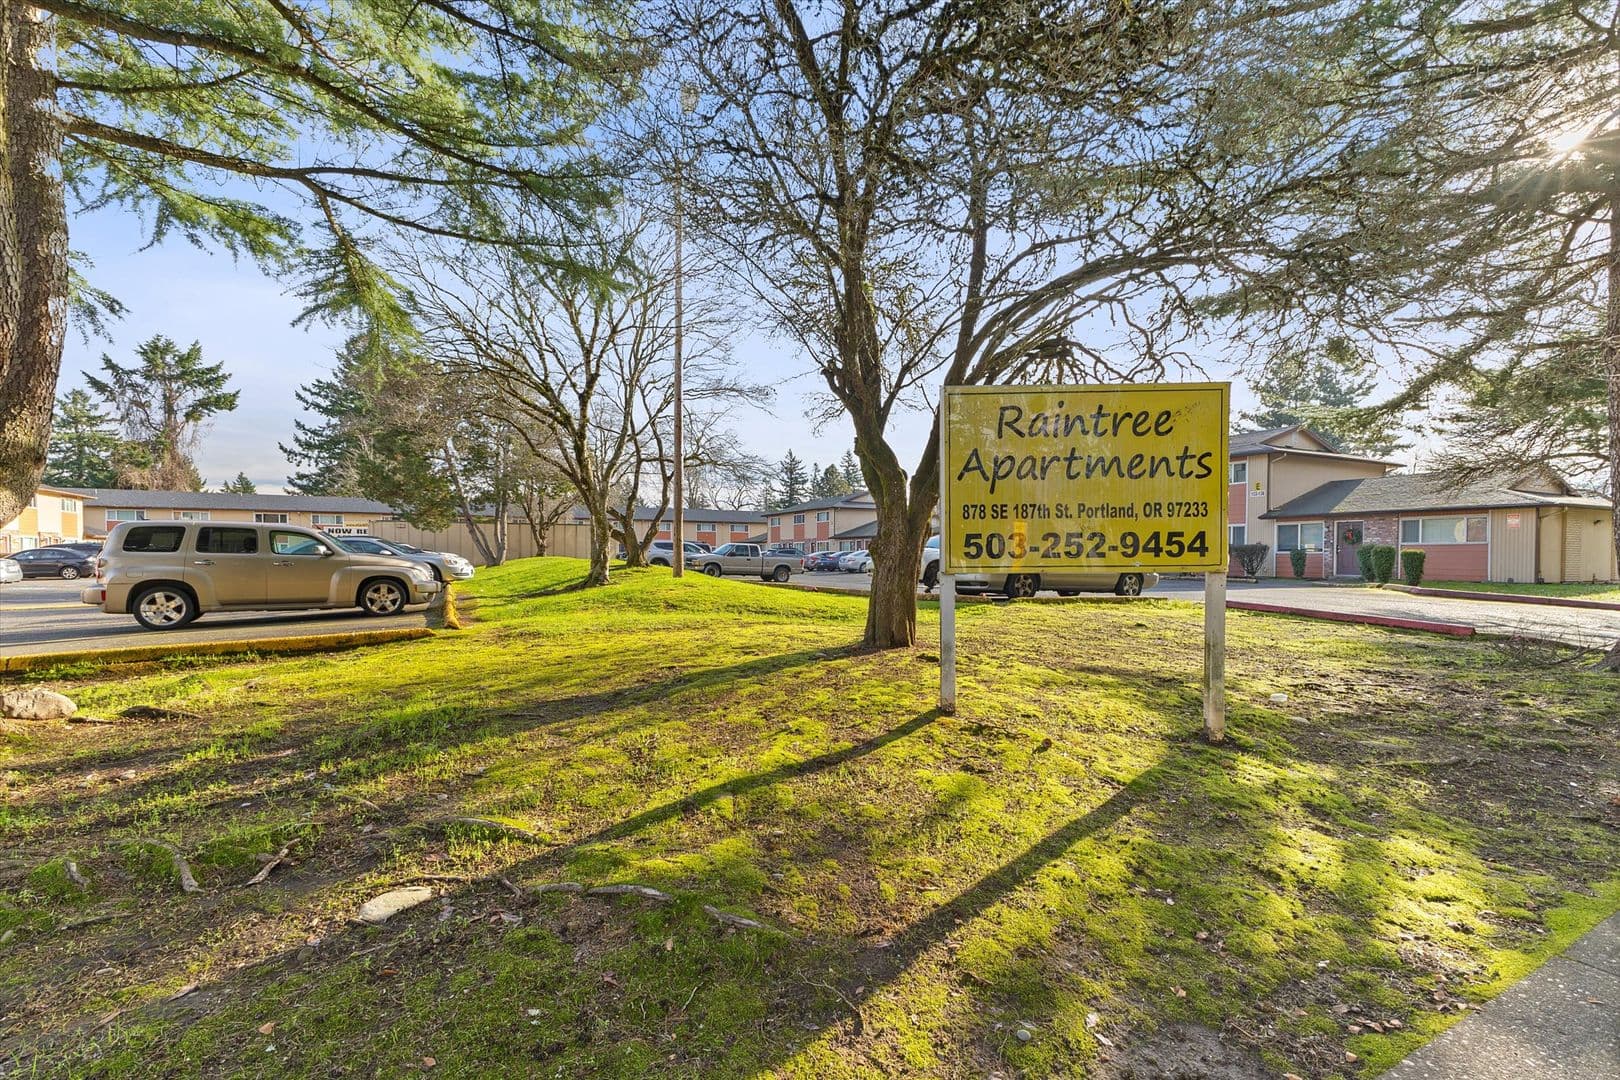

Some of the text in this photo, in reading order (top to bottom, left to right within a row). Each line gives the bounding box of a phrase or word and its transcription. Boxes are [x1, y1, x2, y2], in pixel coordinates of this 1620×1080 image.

[997, 400, 1174, 440] Raintree
[957, 445, 1214, 495] Apartments
[962, 501, 1208, 521] 878 SE 187th St. Portland, OR 97233
[327, 527, 352, 535] NOW
[963, 531, 1209, 560] 503-252-9454
